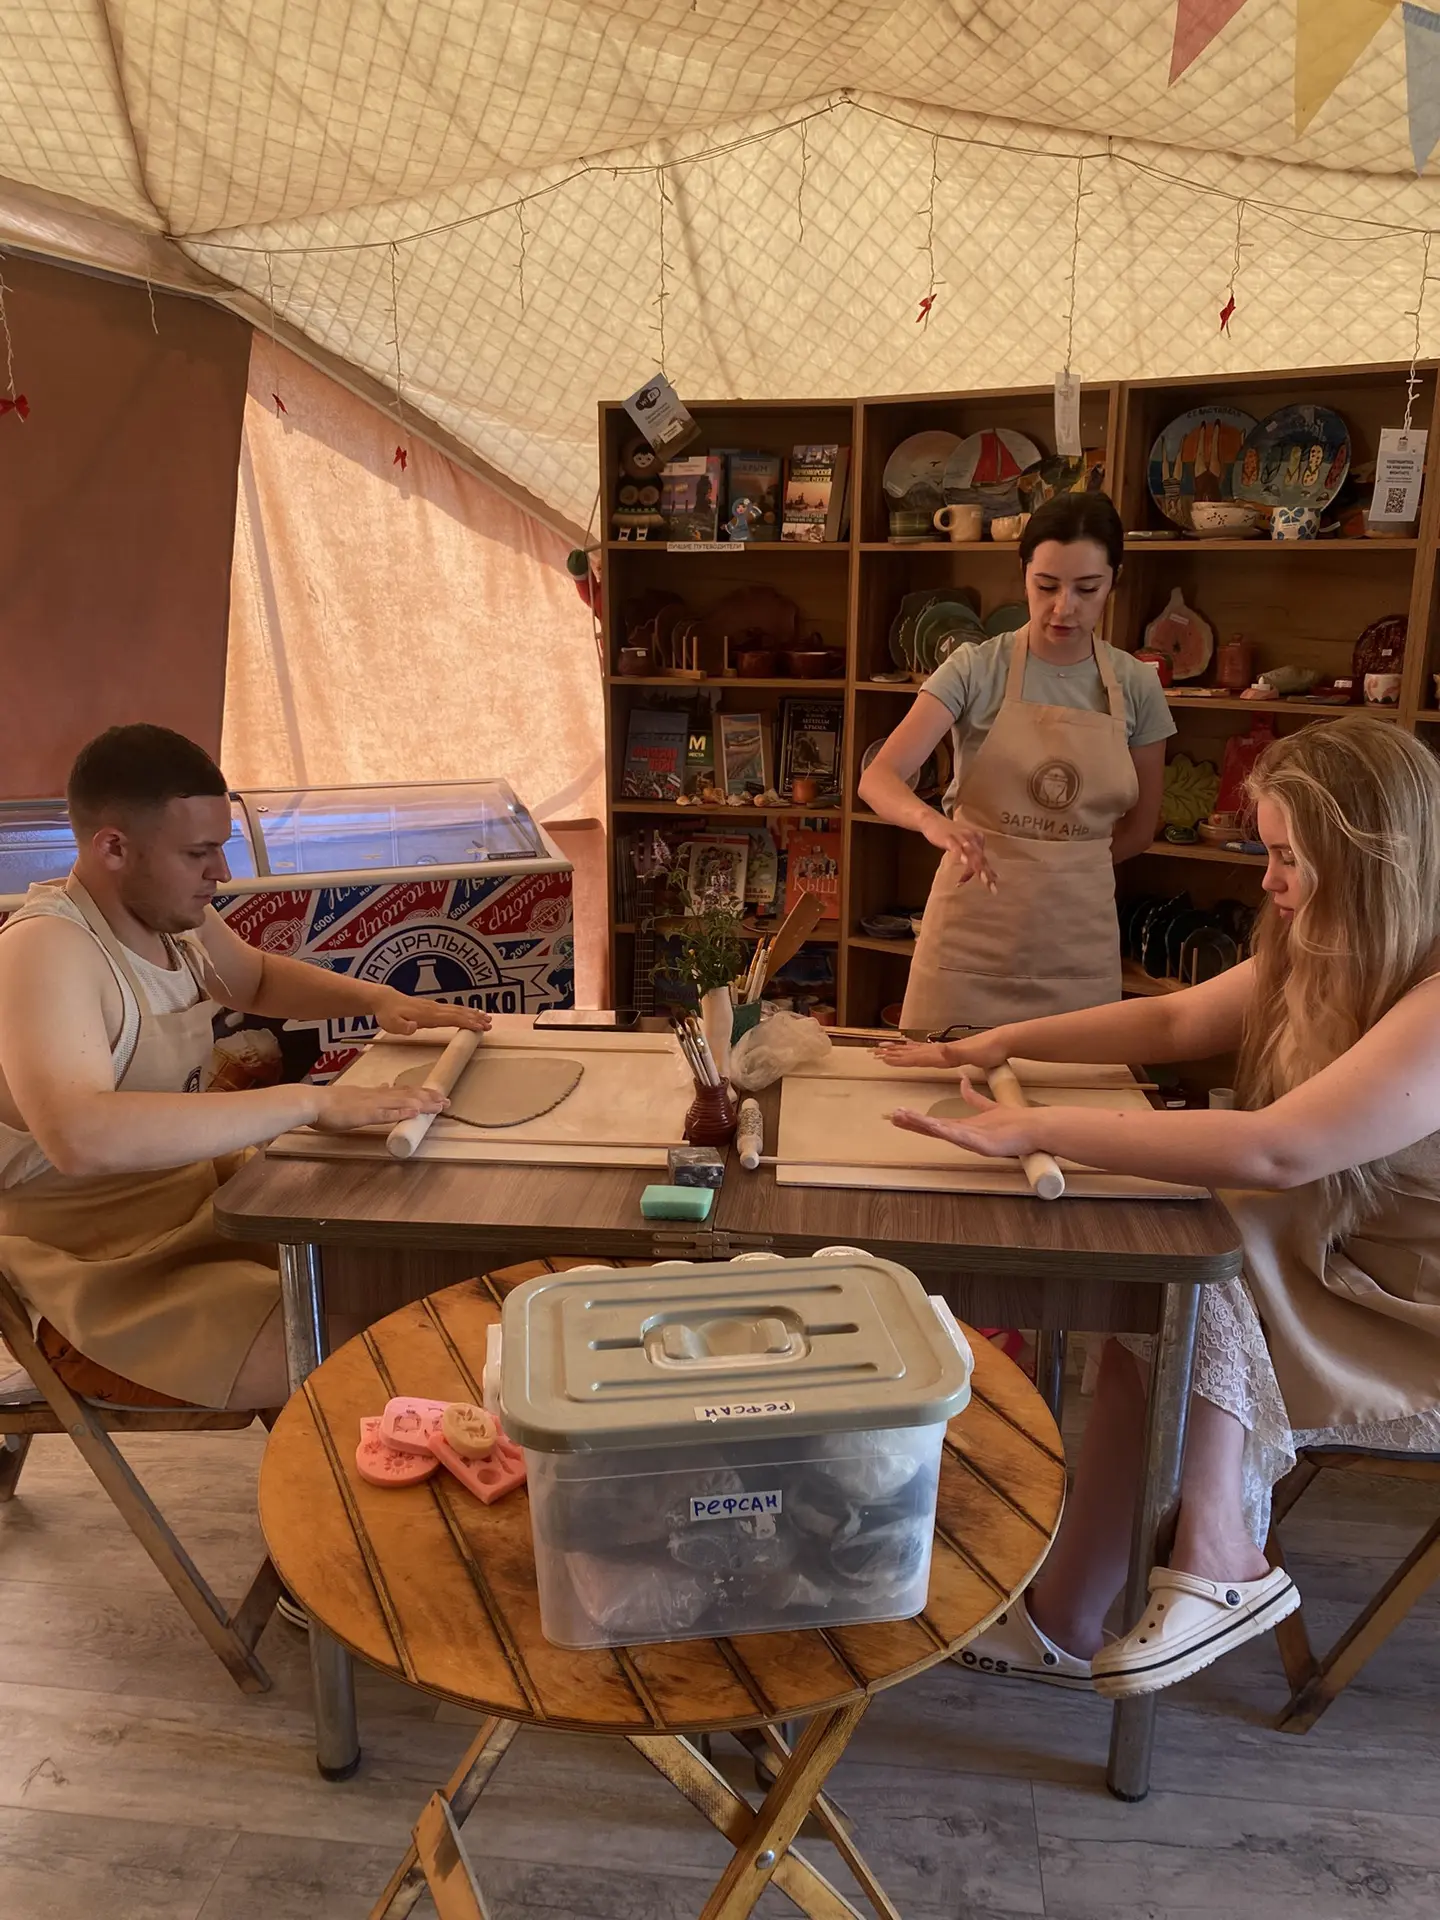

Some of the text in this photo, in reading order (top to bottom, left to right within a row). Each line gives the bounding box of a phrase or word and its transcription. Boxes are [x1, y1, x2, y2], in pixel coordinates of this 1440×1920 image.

[1000, 811, 1056, 833] ЗАРНИ
[450, 899, 471, 920] 600г
[313, 911, 336, 932] 600г
[328, 928, 352, 948] 20%
[510, 942, 531, 960] 20%
